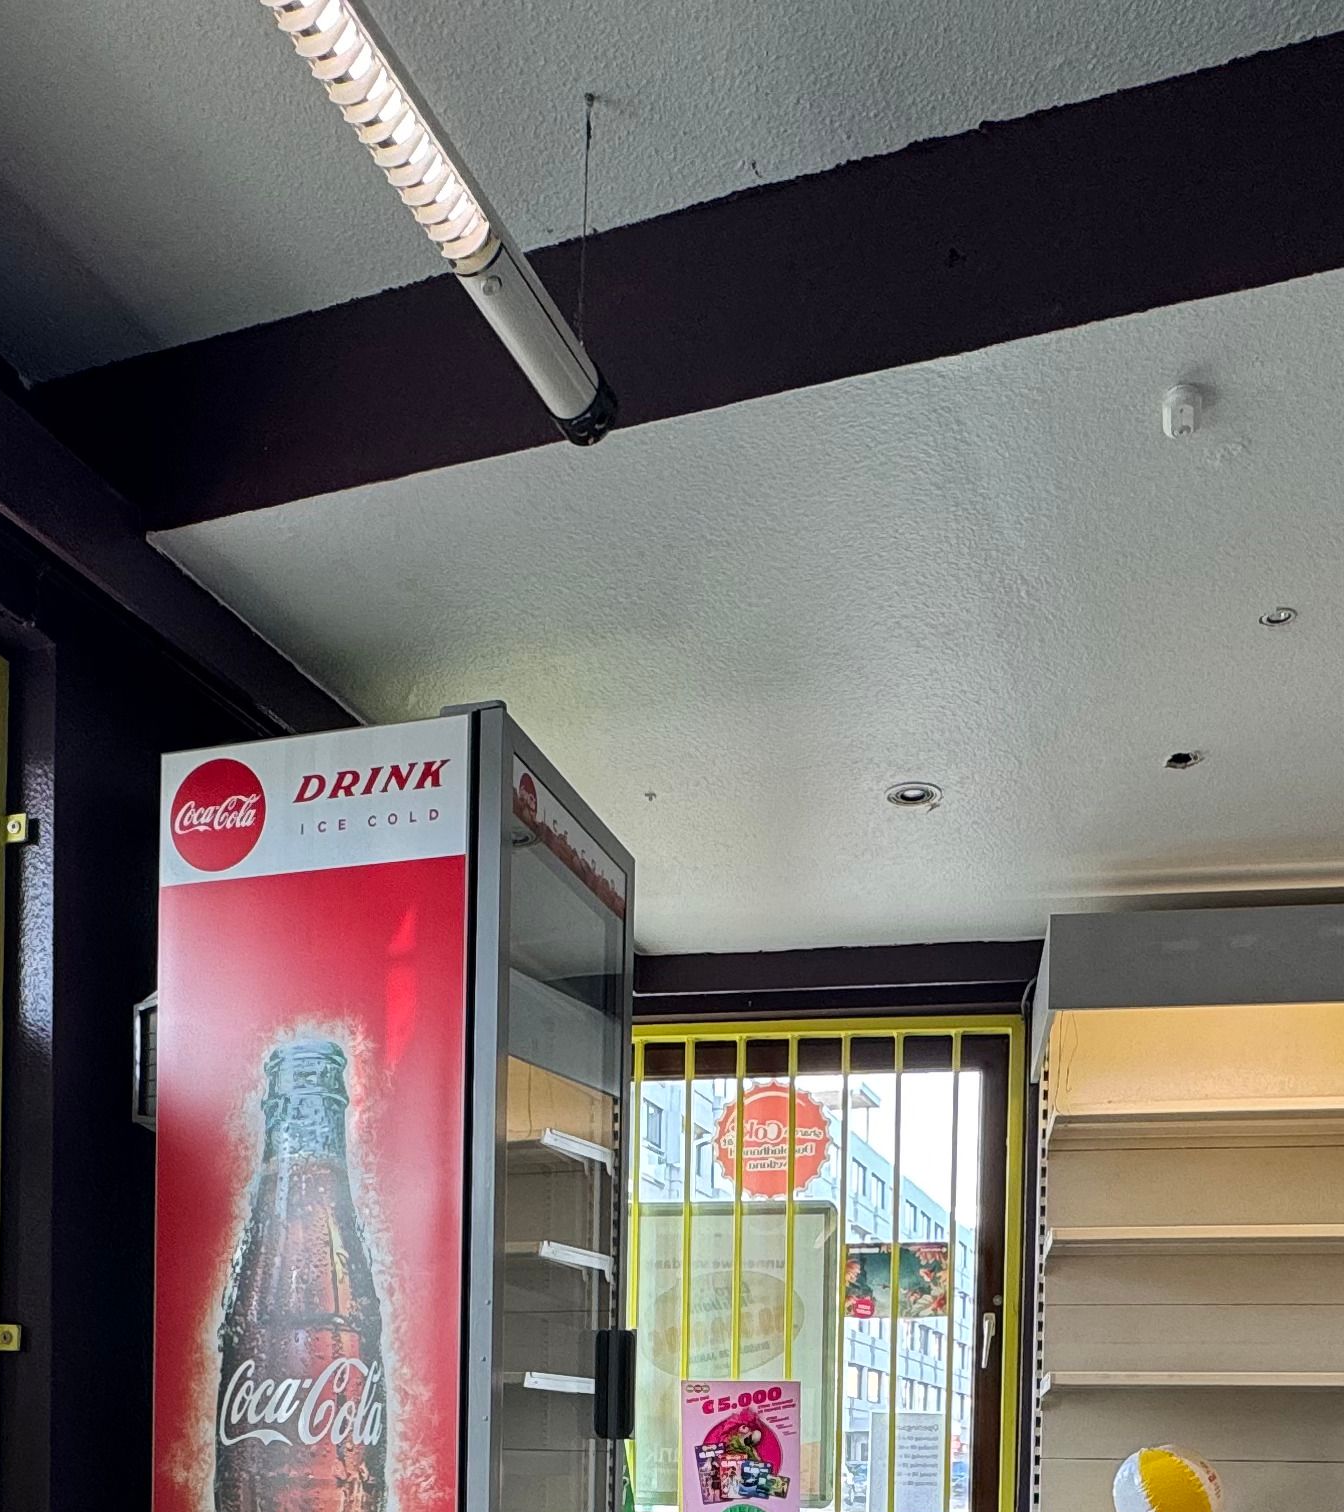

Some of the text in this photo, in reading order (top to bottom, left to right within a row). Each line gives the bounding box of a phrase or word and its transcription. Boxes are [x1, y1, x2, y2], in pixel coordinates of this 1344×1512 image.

[293, 758, 452, 805] DRINK
[175, 793, 261, 835] Coca-Cola
[300, 808, 440, 835] ICE COLD
[219, 1357, 385, 1448] Coca-Cola
